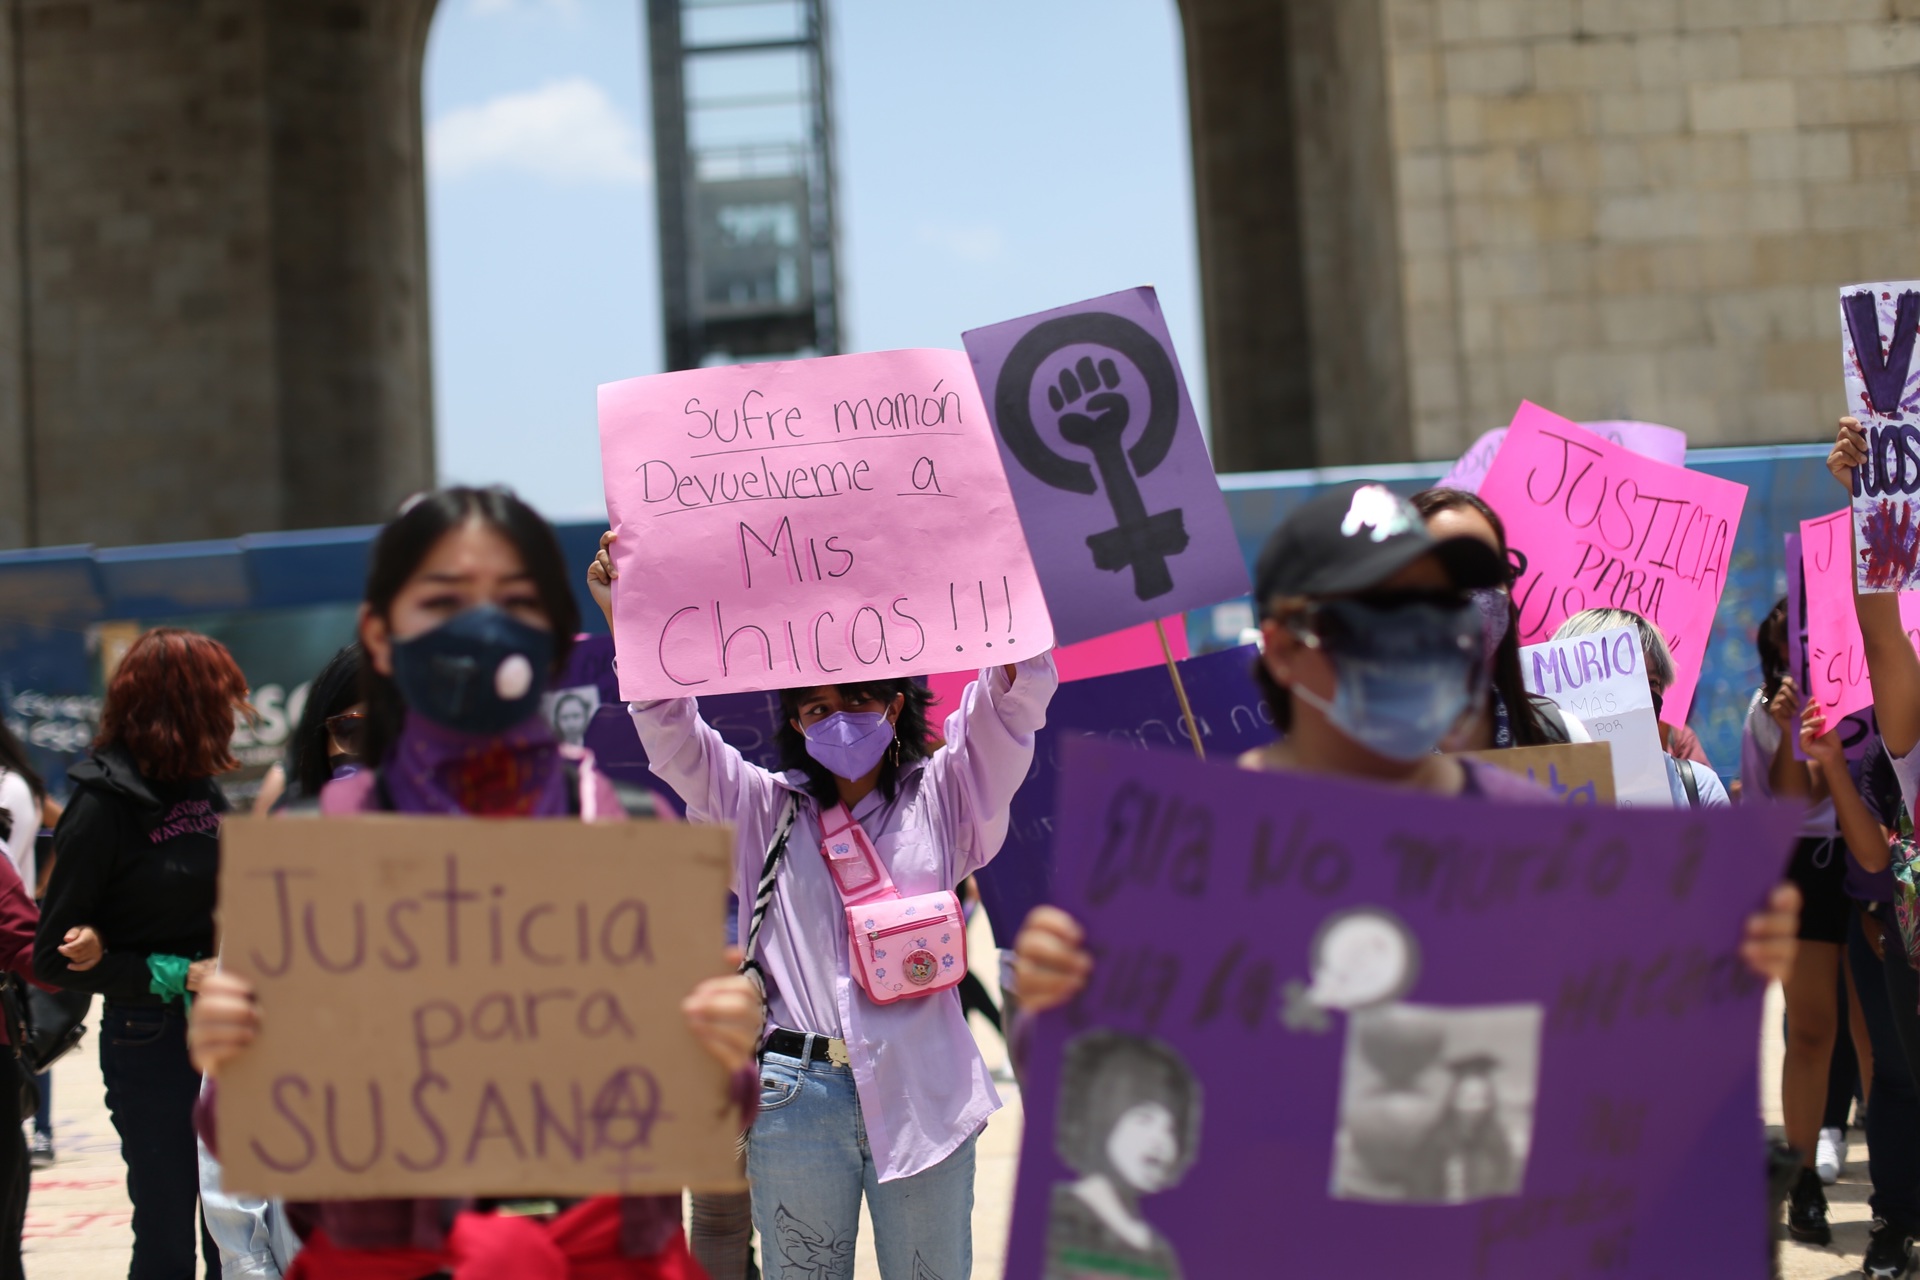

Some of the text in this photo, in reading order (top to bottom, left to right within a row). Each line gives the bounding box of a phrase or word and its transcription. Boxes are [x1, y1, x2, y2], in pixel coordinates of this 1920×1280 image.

[684, 379, 962, 443] Sufre mamón
[635, 456, 942, 507] Devuelveme a
[1527, 430, 1728, 604] JUSTICIA
[1573, 540, 1667, 625] PARA
[1532, 631, 1637, 696] MURIO
[1570, 690, 1618, 720] MÁS
[1595, 719, 1624, 737] POR
[245, 853, 655, 979] Justicia
[412, 987, 637, 1075] para
